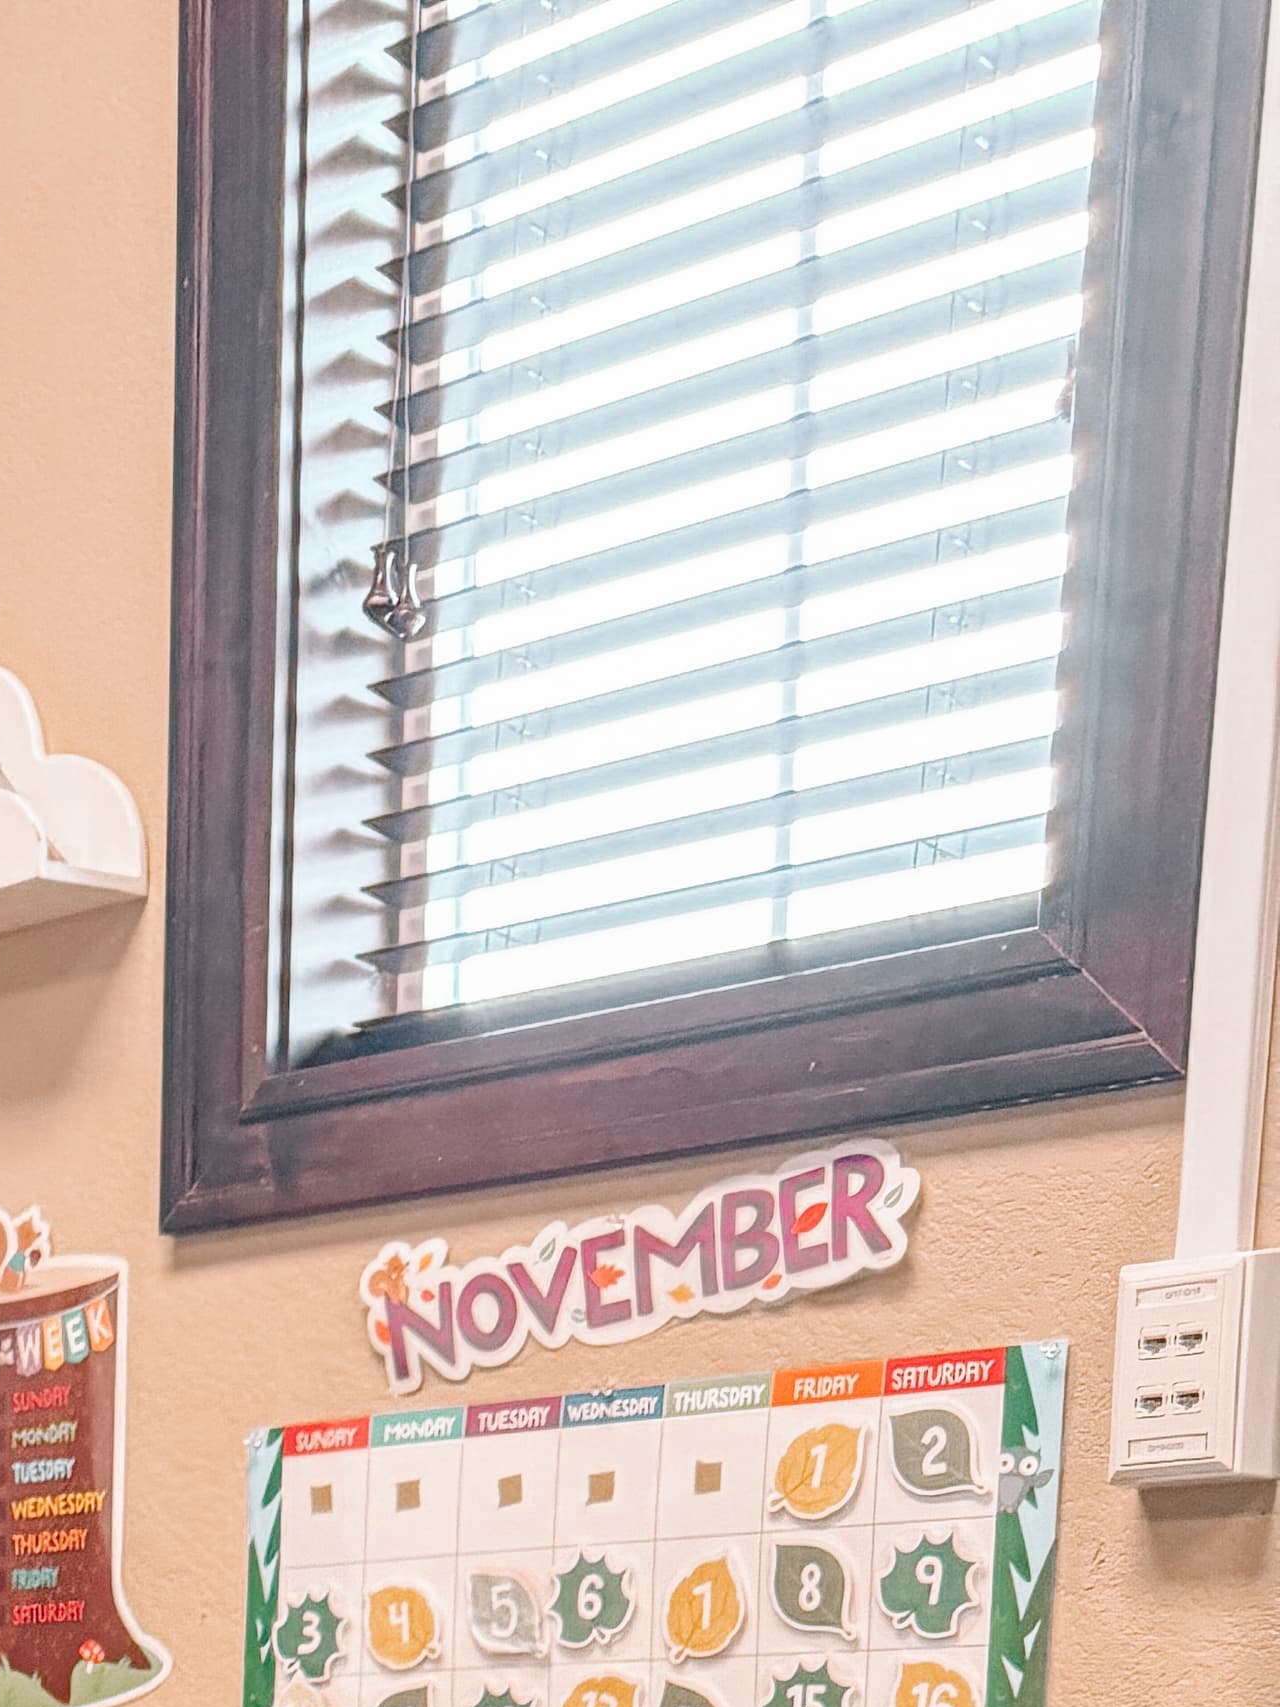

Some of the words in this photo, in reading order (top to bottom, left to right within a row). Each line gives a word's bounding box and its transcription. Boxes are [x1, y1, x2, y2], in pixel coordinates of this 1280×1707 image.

[384, 1154, 892, 1382] NOVEMBER
[17, 1303, 112, 1370] WEEK
[12, 1385, 71, 1413] SUNDAY
[295, 1424, 358, 1452] SUNDAY
[383, 1414, 456, 1442] MONDAY
[477, 1404, 551, 1433] TUESDAY
[566, 1392, 658, 1421] WEDNESDAY
[673, 1383, 767, 1413] THURSDAY
[793, 1372, 859, 1398] FRIDAY
[891, 1358, 995, 1393] SATURDAY
[11, 1421, 78, 1448] MONDAY
[11, 1459, 75, 1483] TUESDAY
[809, 1443, 828, 1488] 1
[920, 1425, 948, 1477] 2
[11, 1491, 105, 1520] WEDNESDAY
[12, 1528, 88, 1556] THURSDAY
[12, 1600, 85, 1626] SATURDAY
[297, 1610, 321, 1655] 3
[387, 1603, 410, 1643] 4
[490, 1584, 518, 1638] 5
[577, 1574, 605, 1620] 6
[797, 1562, 822, 1612] 8
[915, 1555, 943, 1606] 9
